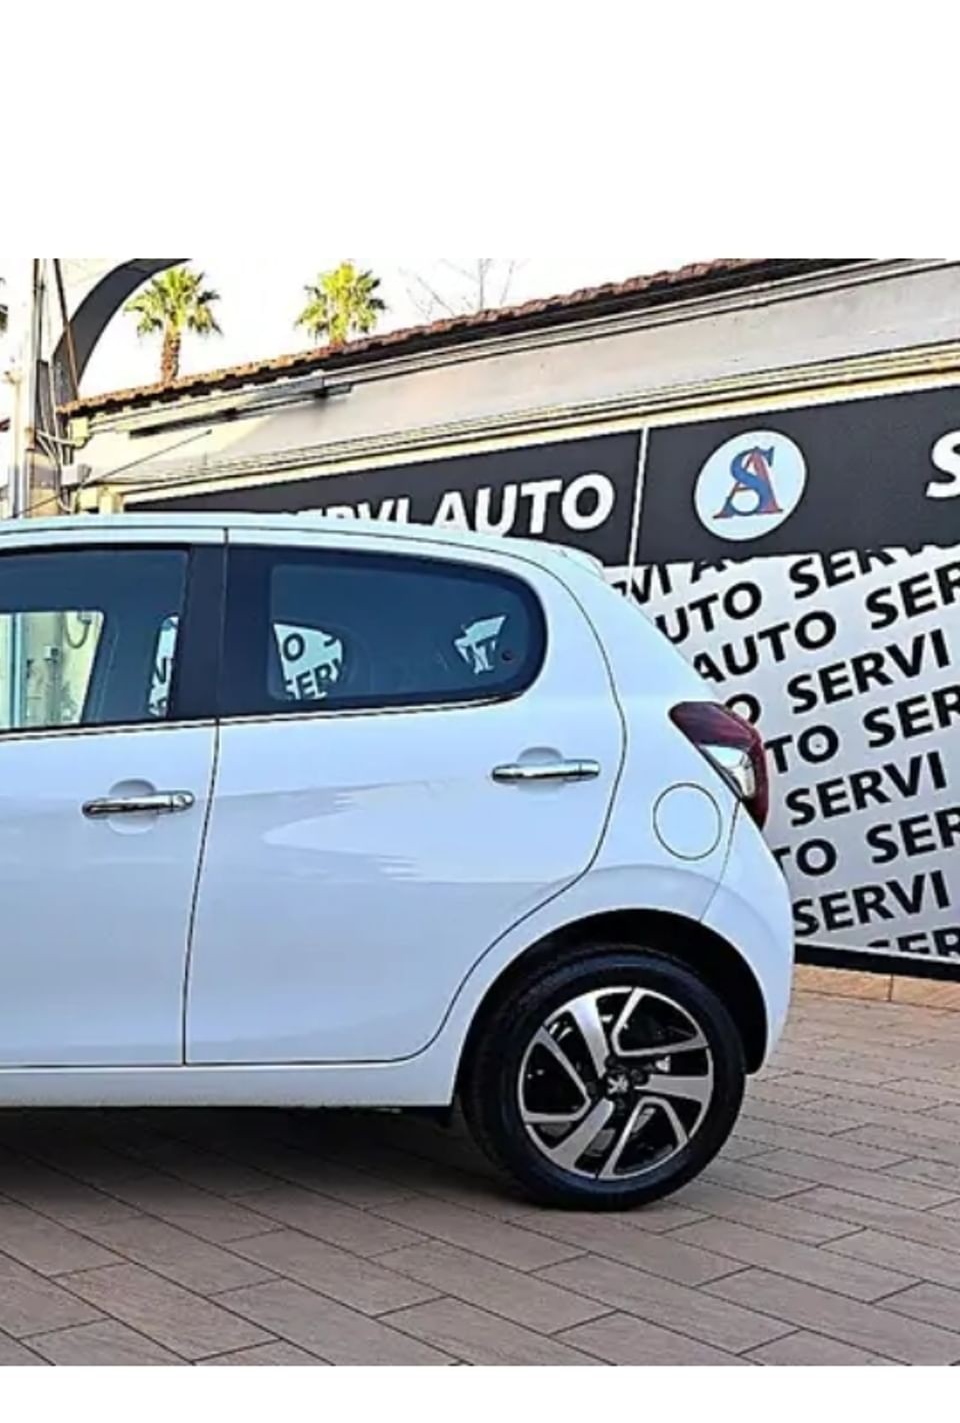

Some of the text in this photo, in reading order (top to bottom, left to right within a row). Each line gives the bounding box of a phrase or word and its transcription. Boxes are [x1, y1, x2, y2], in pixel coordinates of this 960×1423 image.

[433, 474, 616, 536] AUTO
[693, 611, 836, 683] AUTO
[787, 628, 951, 714] SERVI
[785, 751, 947, 827] SERVI
[792, 869, 950, 937] SERVI
